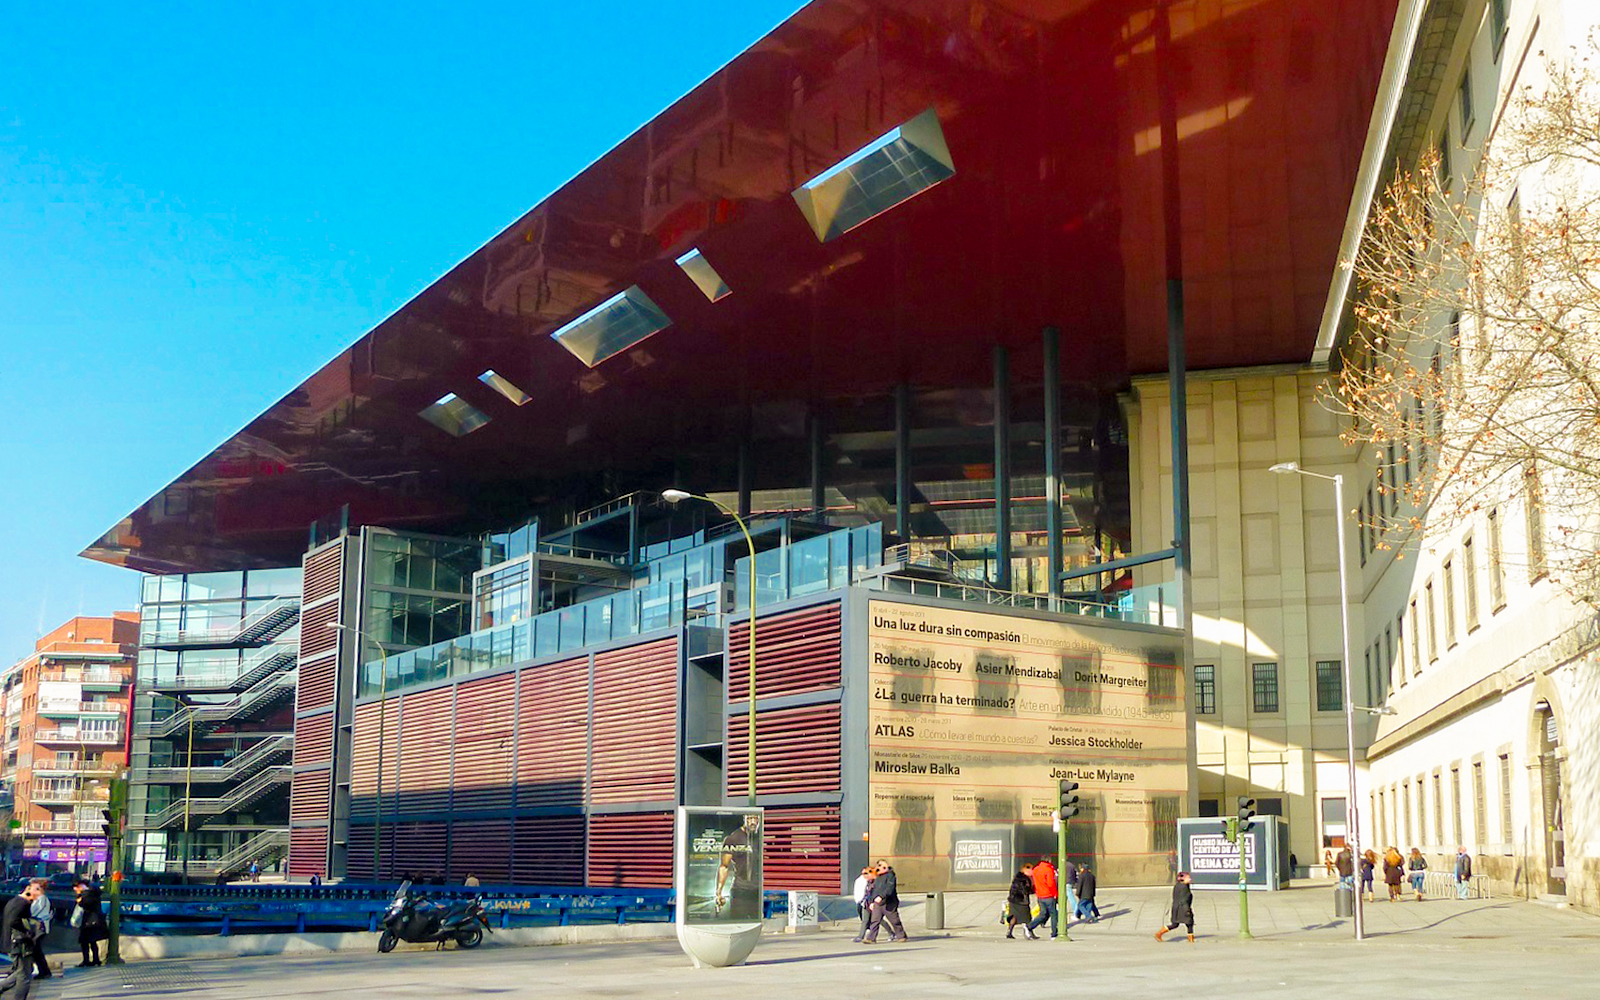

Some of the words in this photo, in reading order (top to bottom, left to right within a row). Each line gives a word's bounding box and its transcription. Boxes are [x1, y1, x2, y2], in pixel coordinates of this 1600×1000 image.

[874, 616, 897, 629] Una
[899, 618, 916, 631] luz
[918, 621, 944, 635] dura
[946, 624, 962, 637] sin
[964, 629, 1021, 643] compasión
[1030, 636, 1070, 649] movimiento
[1072, 640, 1082, 650] de
[874, 652, 920, 667] Roberto
[923, 658, 962, 673] Jacoby
[976, 662, 1002, 675] Asier
[1004, 664, 1062, 680] Mendizabal
[1074, 671, 1098, 684] Dorit
[1100, 673, 1148, 688] Margreiter
[874, 688, 896, 700] ¿La
[901, 692, 937, 704] guerra
[940, 693, 953, 704] ha
[956, 695, 1016, 708] terminado?
[1019, 699, 1038, 711] Arte
[1039, 702, 1050, 712] en
[1052, 702, 1062, 713] un
[874, 724, 914, 738] ATLAS
[918, 729, 946, 740] ¿Cómo
[968, 732, 974, 742] el
[976, 732, 1000, 744] mundo
[1007, 734, 1038, 745] cuestas?
[1049, 735, 1086, 746] Jessica
[1088, 737, 1142, 750] Stockholder
[874, 761, 927, 774] Miroslaw
[930, 763, 960, 775] Balka
[1050, 768, 1095, 780] Jean-Luc
[1096, 770, 1135, 783] Mylayne
[1194, 846, 1220, 854] CENTRO
[1194, 858, 1222, 869] REINA
[1222, 858, 1252, 869] SOFA
